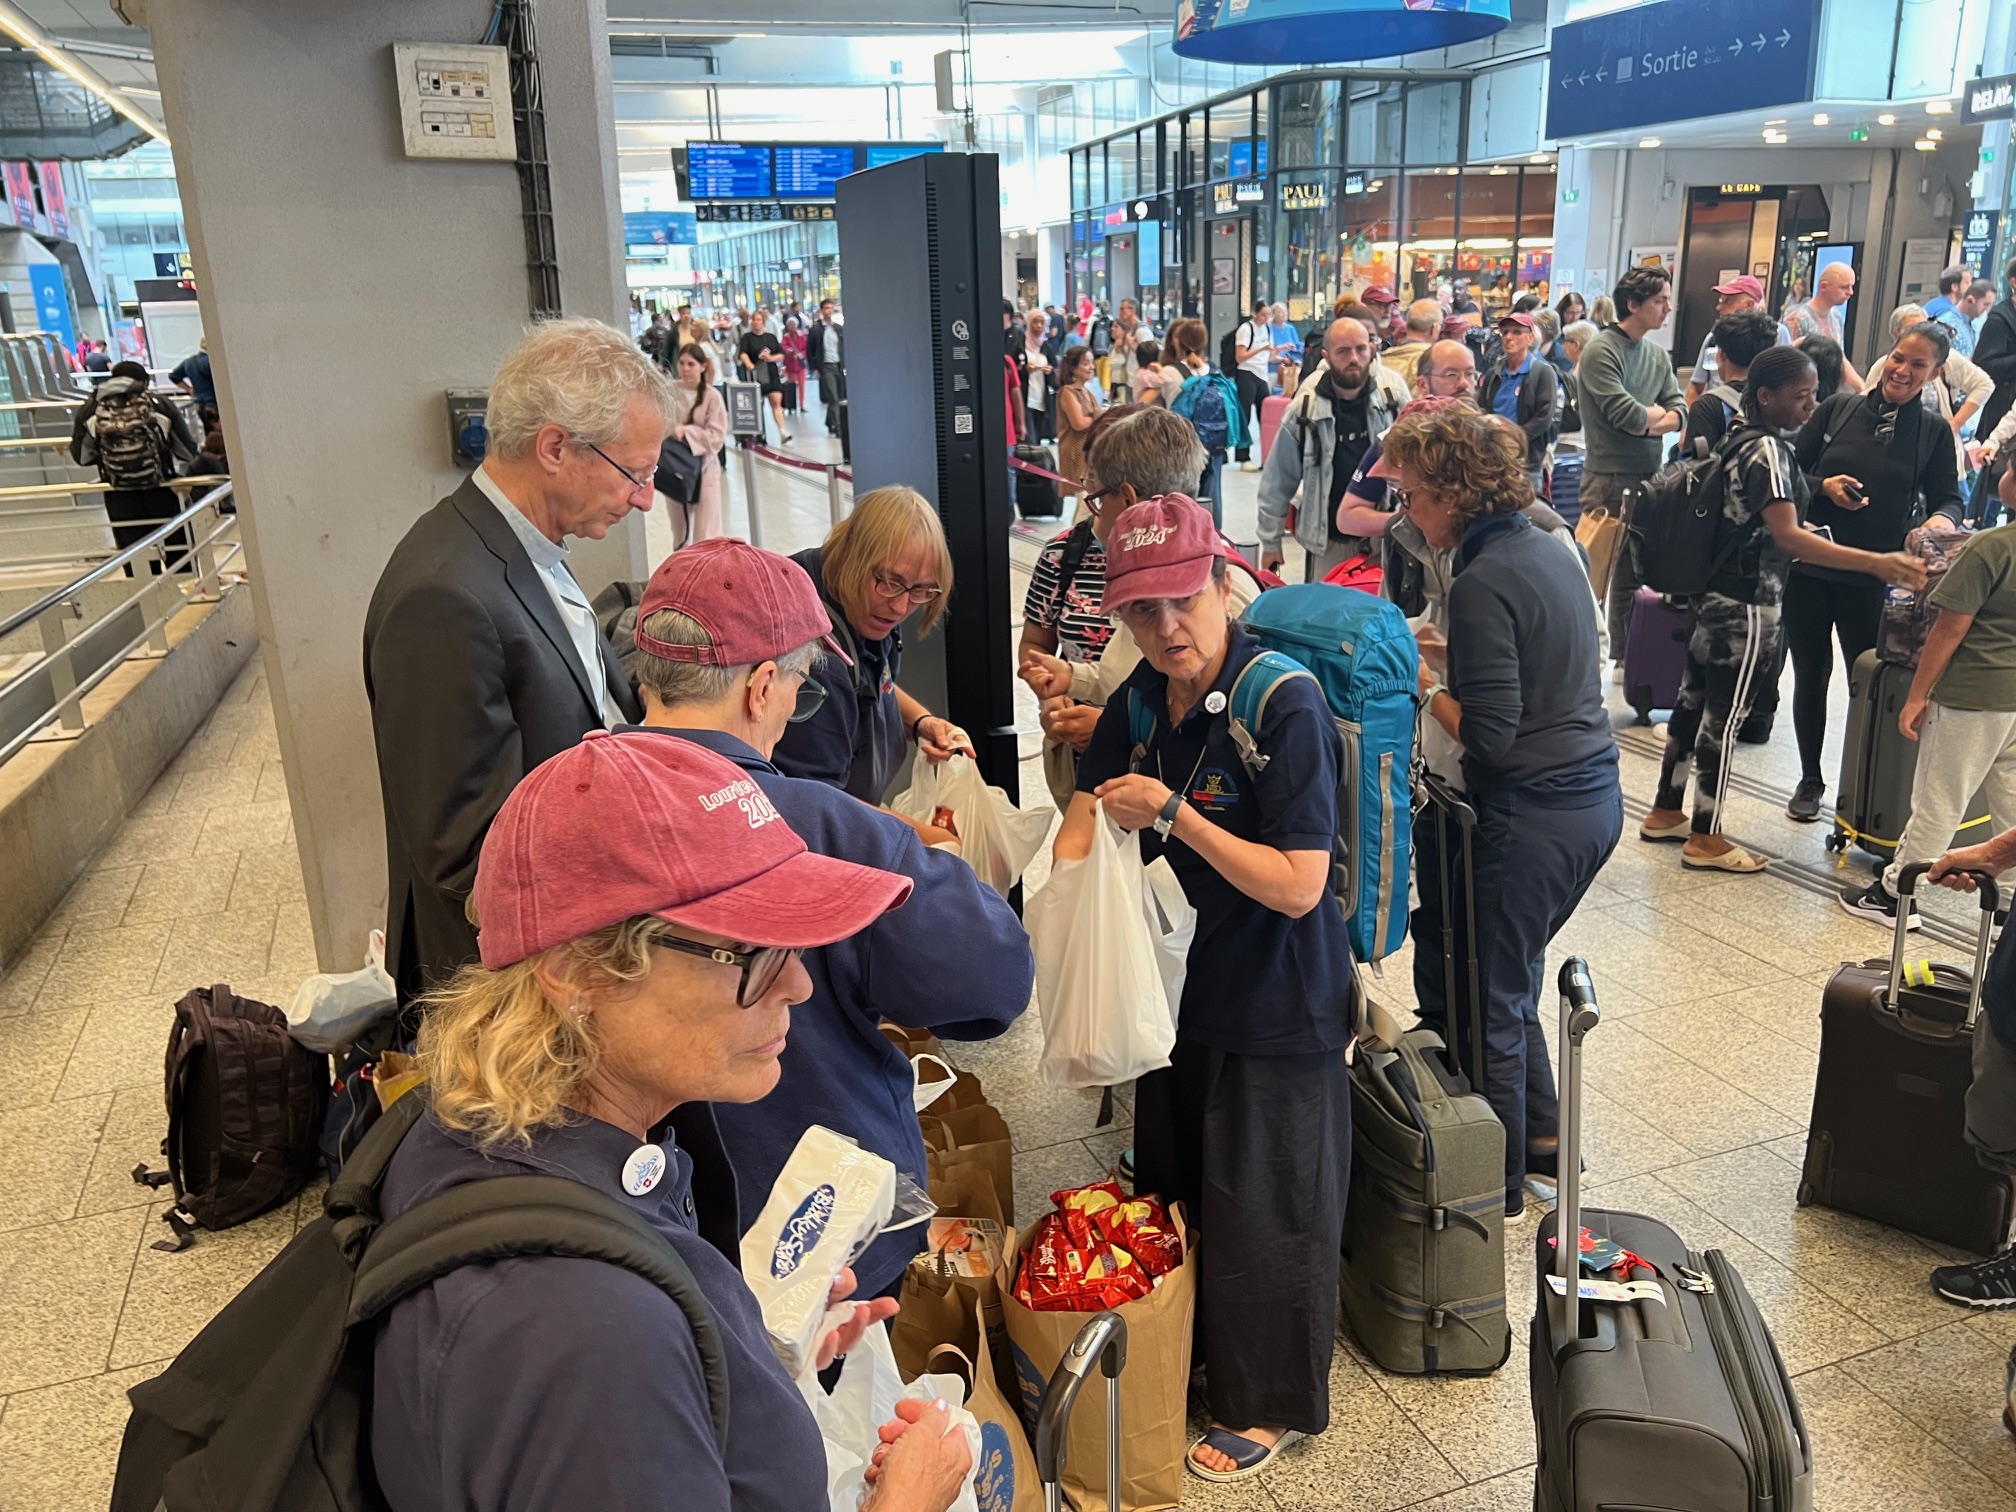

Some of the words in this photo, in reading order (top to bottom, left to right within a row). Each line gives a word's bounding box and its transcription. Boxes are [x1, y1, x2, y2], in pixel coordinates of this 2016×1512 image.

[1641, 45, 1698, 77] Sortie
[1971, 85, 2011, 113] RELAY
[1283, 183, 1328, 200] PAUL
[1285, 200, 1298, 208] LE
[736, 412, 755, 420] Sortie
[1124, 528, 1167, 551] 2024
[698, 779, 755, 811] Lourdes
